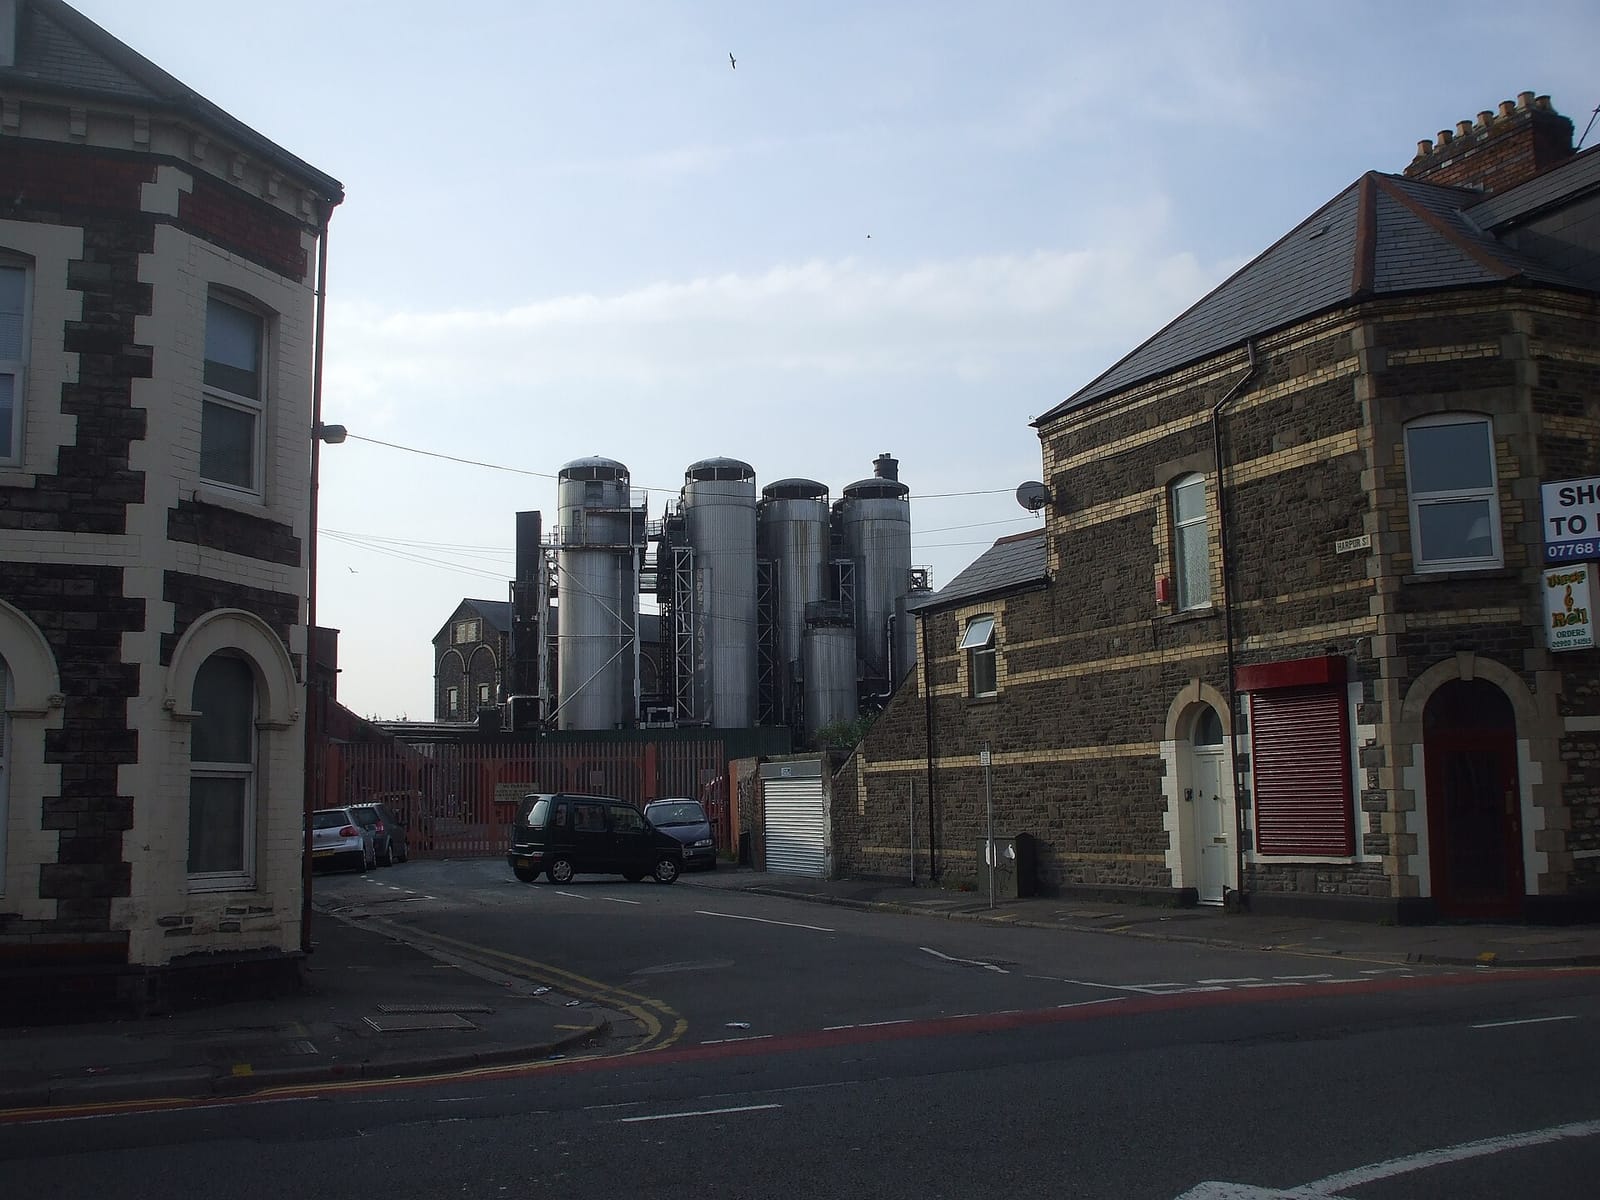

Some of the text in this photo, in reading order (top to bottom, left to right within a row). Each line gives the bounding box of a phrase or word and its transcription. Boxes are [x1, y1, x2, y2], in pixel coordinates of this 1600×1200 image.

[1549, 514, 1587, 536] TO
[1548, 543, 1594, 557] 07768
[1556, 628, 1586, 639] ORDERS
